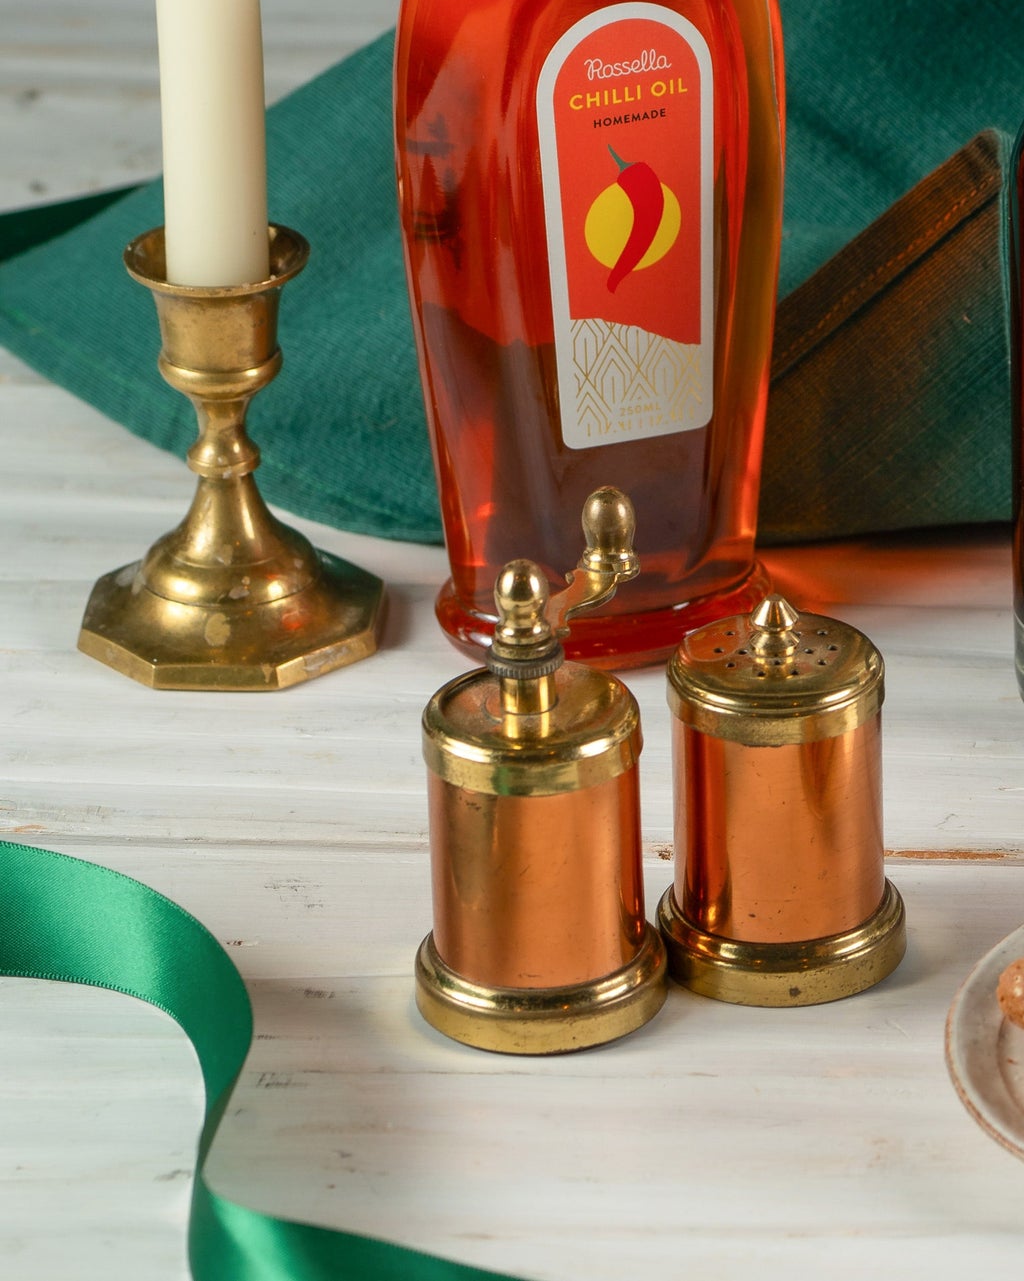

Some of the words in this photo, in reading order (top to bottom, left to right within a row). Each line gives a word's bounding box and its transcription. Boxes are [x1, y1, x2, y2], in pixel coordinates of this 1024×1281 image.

[583, 48, 672, 81] Rossella
[569, 84, 642, 111] CHILLI
[650, 77, 688, 97] OIL
[593, 108, 667, 128] HOMEMADE
